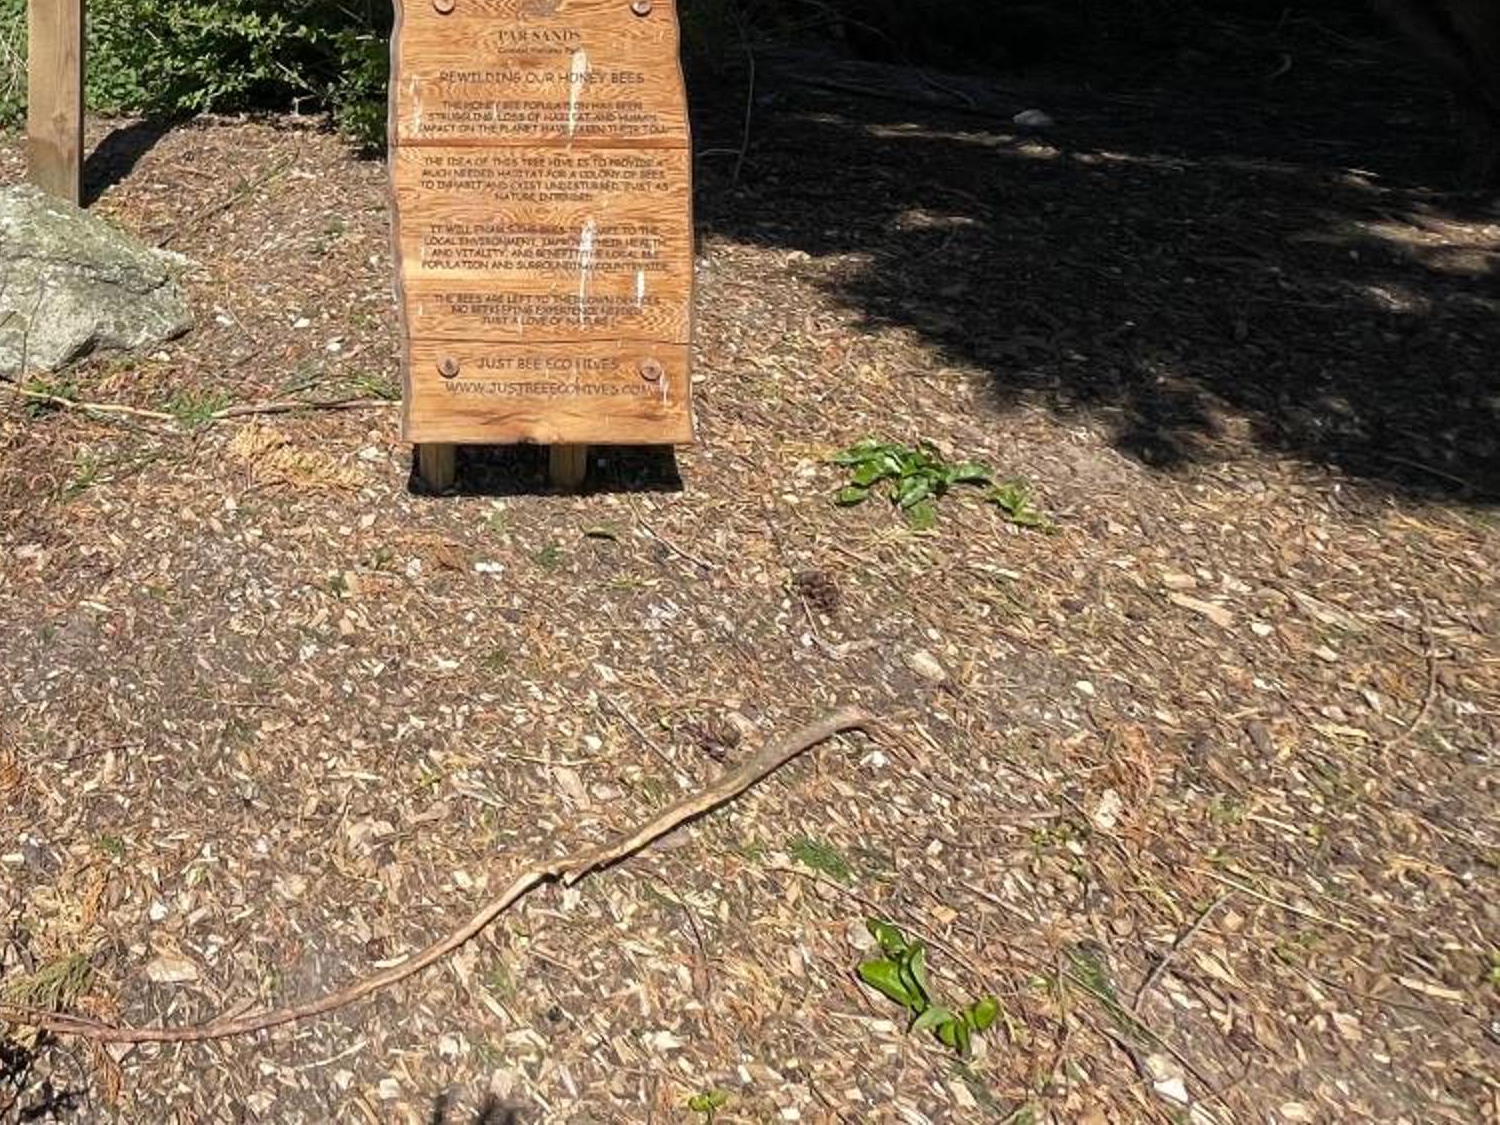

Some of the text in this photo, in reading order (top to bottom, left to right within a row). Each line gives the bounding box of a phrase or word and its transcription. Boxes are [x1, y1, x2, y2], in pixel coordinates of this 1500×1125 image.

[498, 30, 581, 42] PAR SANDS
[439, 71, 645, 84] REWILDING OUR HONEY BEES
[523, 100, 589, 110] POPULATON
[478, 123, 497, 134] THE
[499, 123, 538, 134] PLANET
[424, 157, 443, 167] THE
[446, 157, 473, 167] IDEA
[492, 157, 518, 167] THIS
[520, 157, 545, 167] TREE
[593, 157, 607, 167] TO
[421, 179, 434, 189] TO
[451, 305, 468, 315] NO
[476, 357, 620, 370] JUST BEE ECO HIVES
